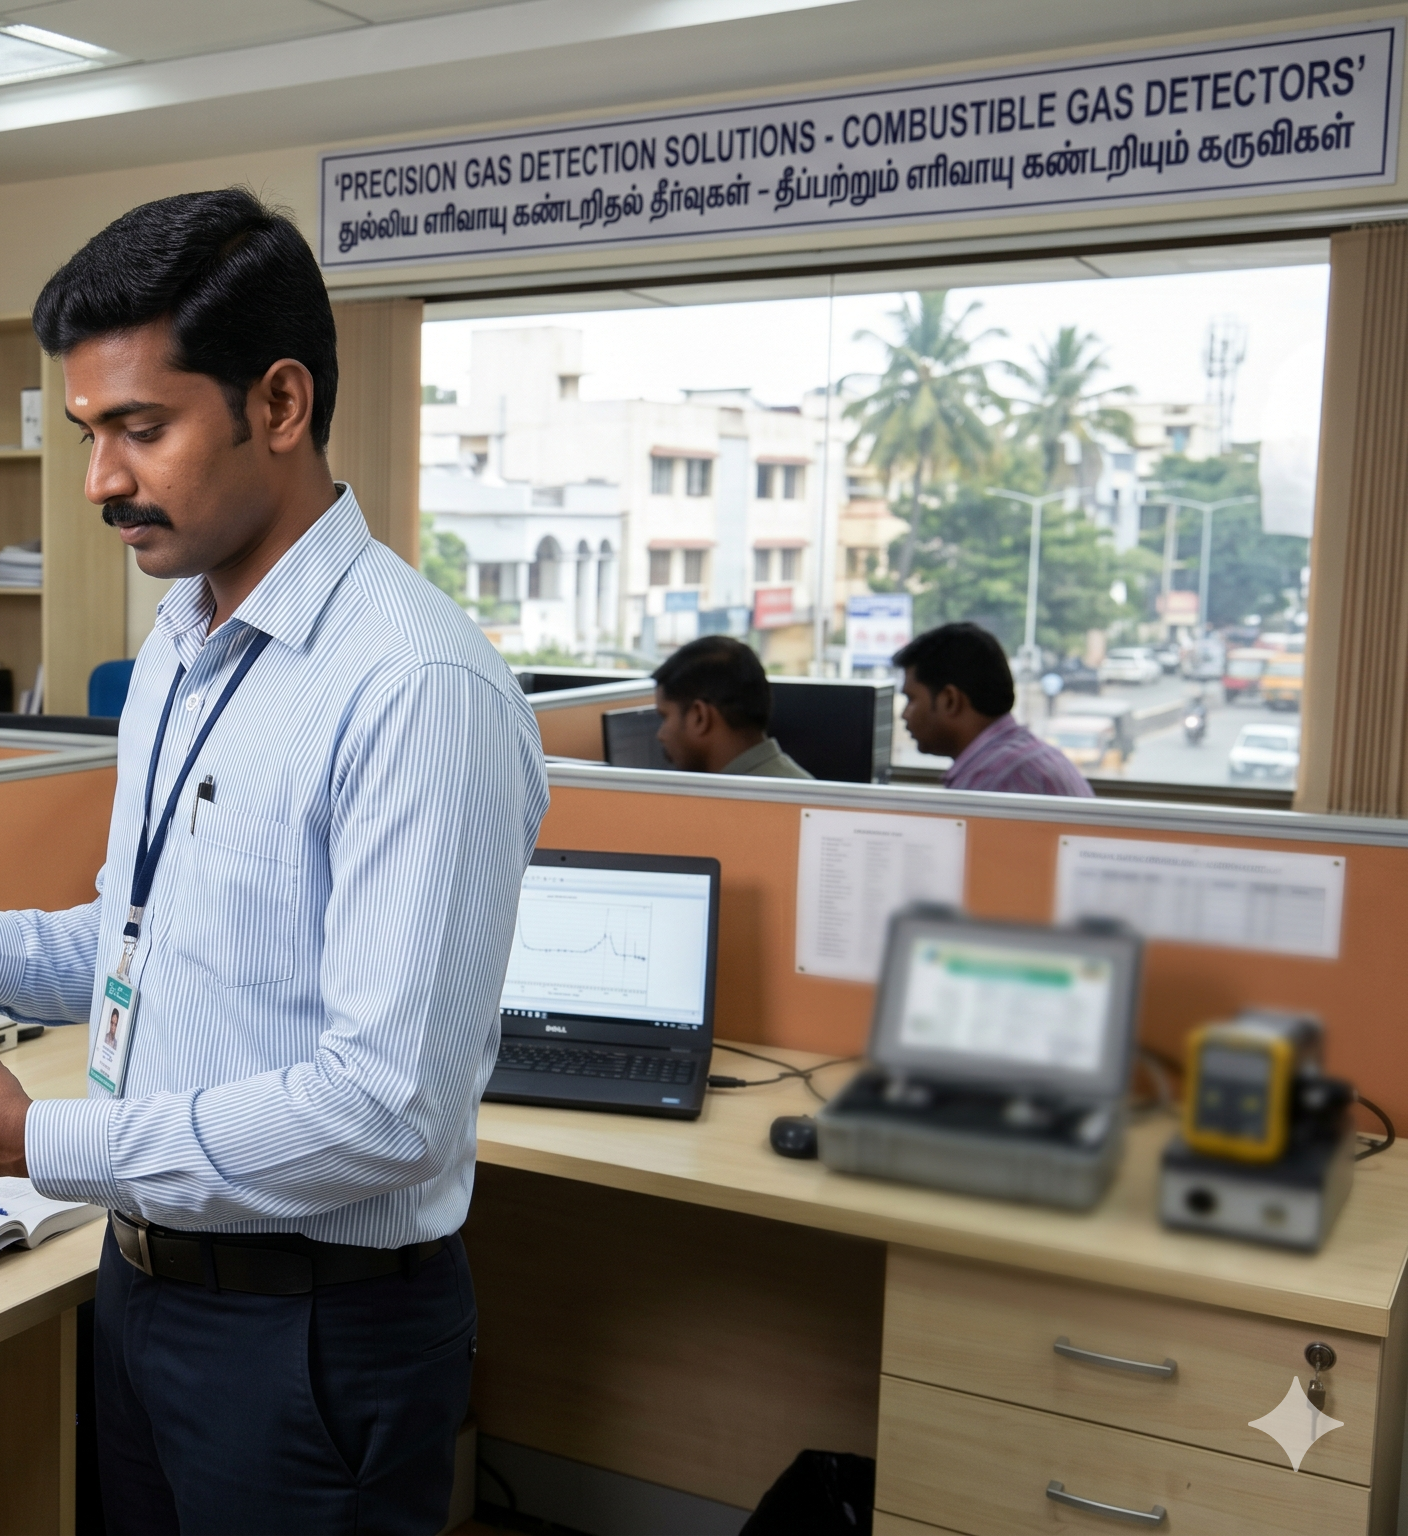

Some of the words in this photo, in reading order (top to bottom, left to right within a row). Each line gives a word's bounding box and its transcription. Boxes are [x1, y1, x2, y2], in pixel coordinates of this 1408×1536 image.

[338, 207, 418, 253] துல்லிய
[424, 201, 508, 236] எரிவாயு
[512, 183, 643, 230] கண்டறிதல்
[649, 172, 752, 224] தீர்வுகள்
[774, 158, 899, 212] தீப்பற்றும்
[906, 152, 1014, 190] எரிவாயு
[1022, 128, 1189, 182] கண்டறியும்
[1198, 110, 1355, 169] கருவிகள்
[464, 153, 512, 189] GAS
[520, 137, 656, 184] DETECTION
[664, 119, 816, 168] SOLUTIONS
[842, 91, 1057, 149] COMBUSTIBLE
[1066, 82, 1133, 126] GAS
